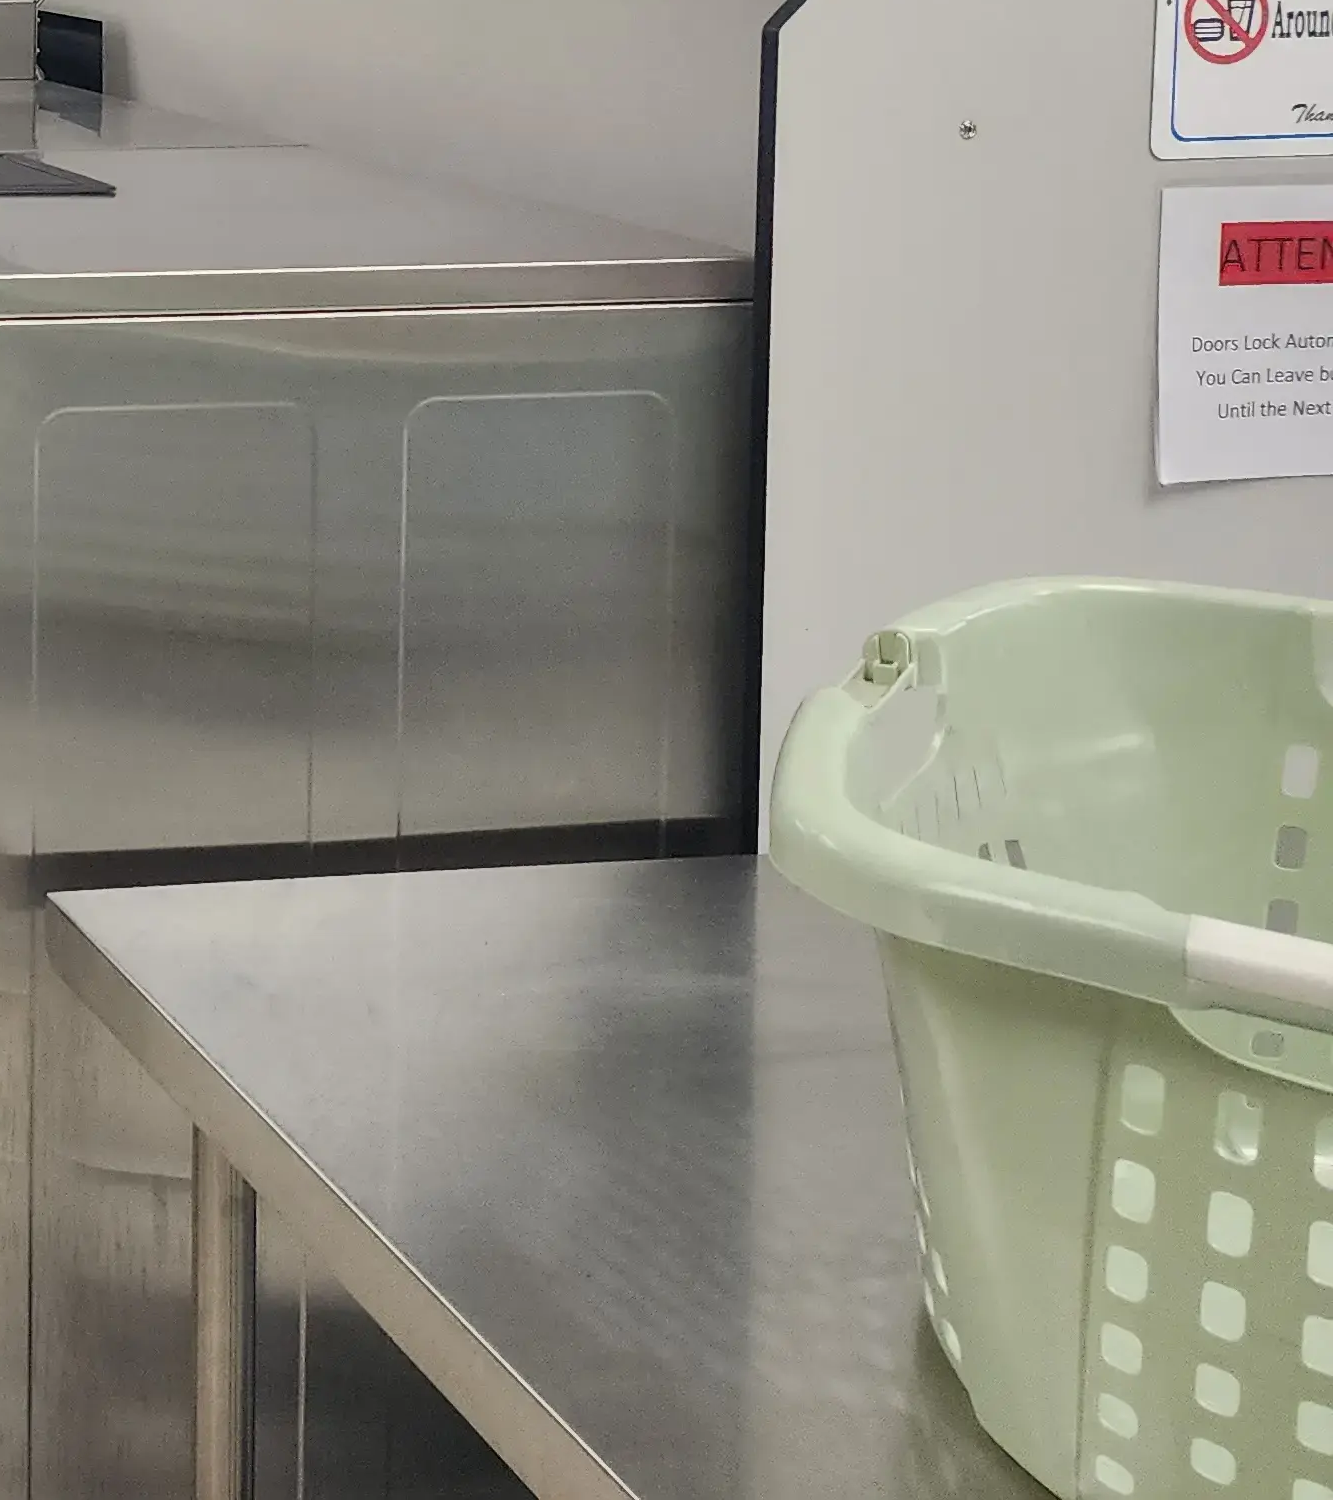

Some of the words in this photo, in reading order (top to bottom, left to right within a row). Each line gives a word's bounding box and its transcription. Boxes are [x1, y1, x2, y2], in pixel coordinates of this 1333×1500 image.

[1271, 0, 1333, 39] Aroun
[1192, 336, 1238, 353] Doors
[1244, 333, 1281, 351] Lock
[1196, 369, 1226, 387] You
[1232, 368, 1261, 385] Can
[1266, 367, 1314, 383] Leave
[1217, 401, 1255, 419] Until
[1260, 400, 1287, 417] the
[1293, 400, 1332, 416] Next
